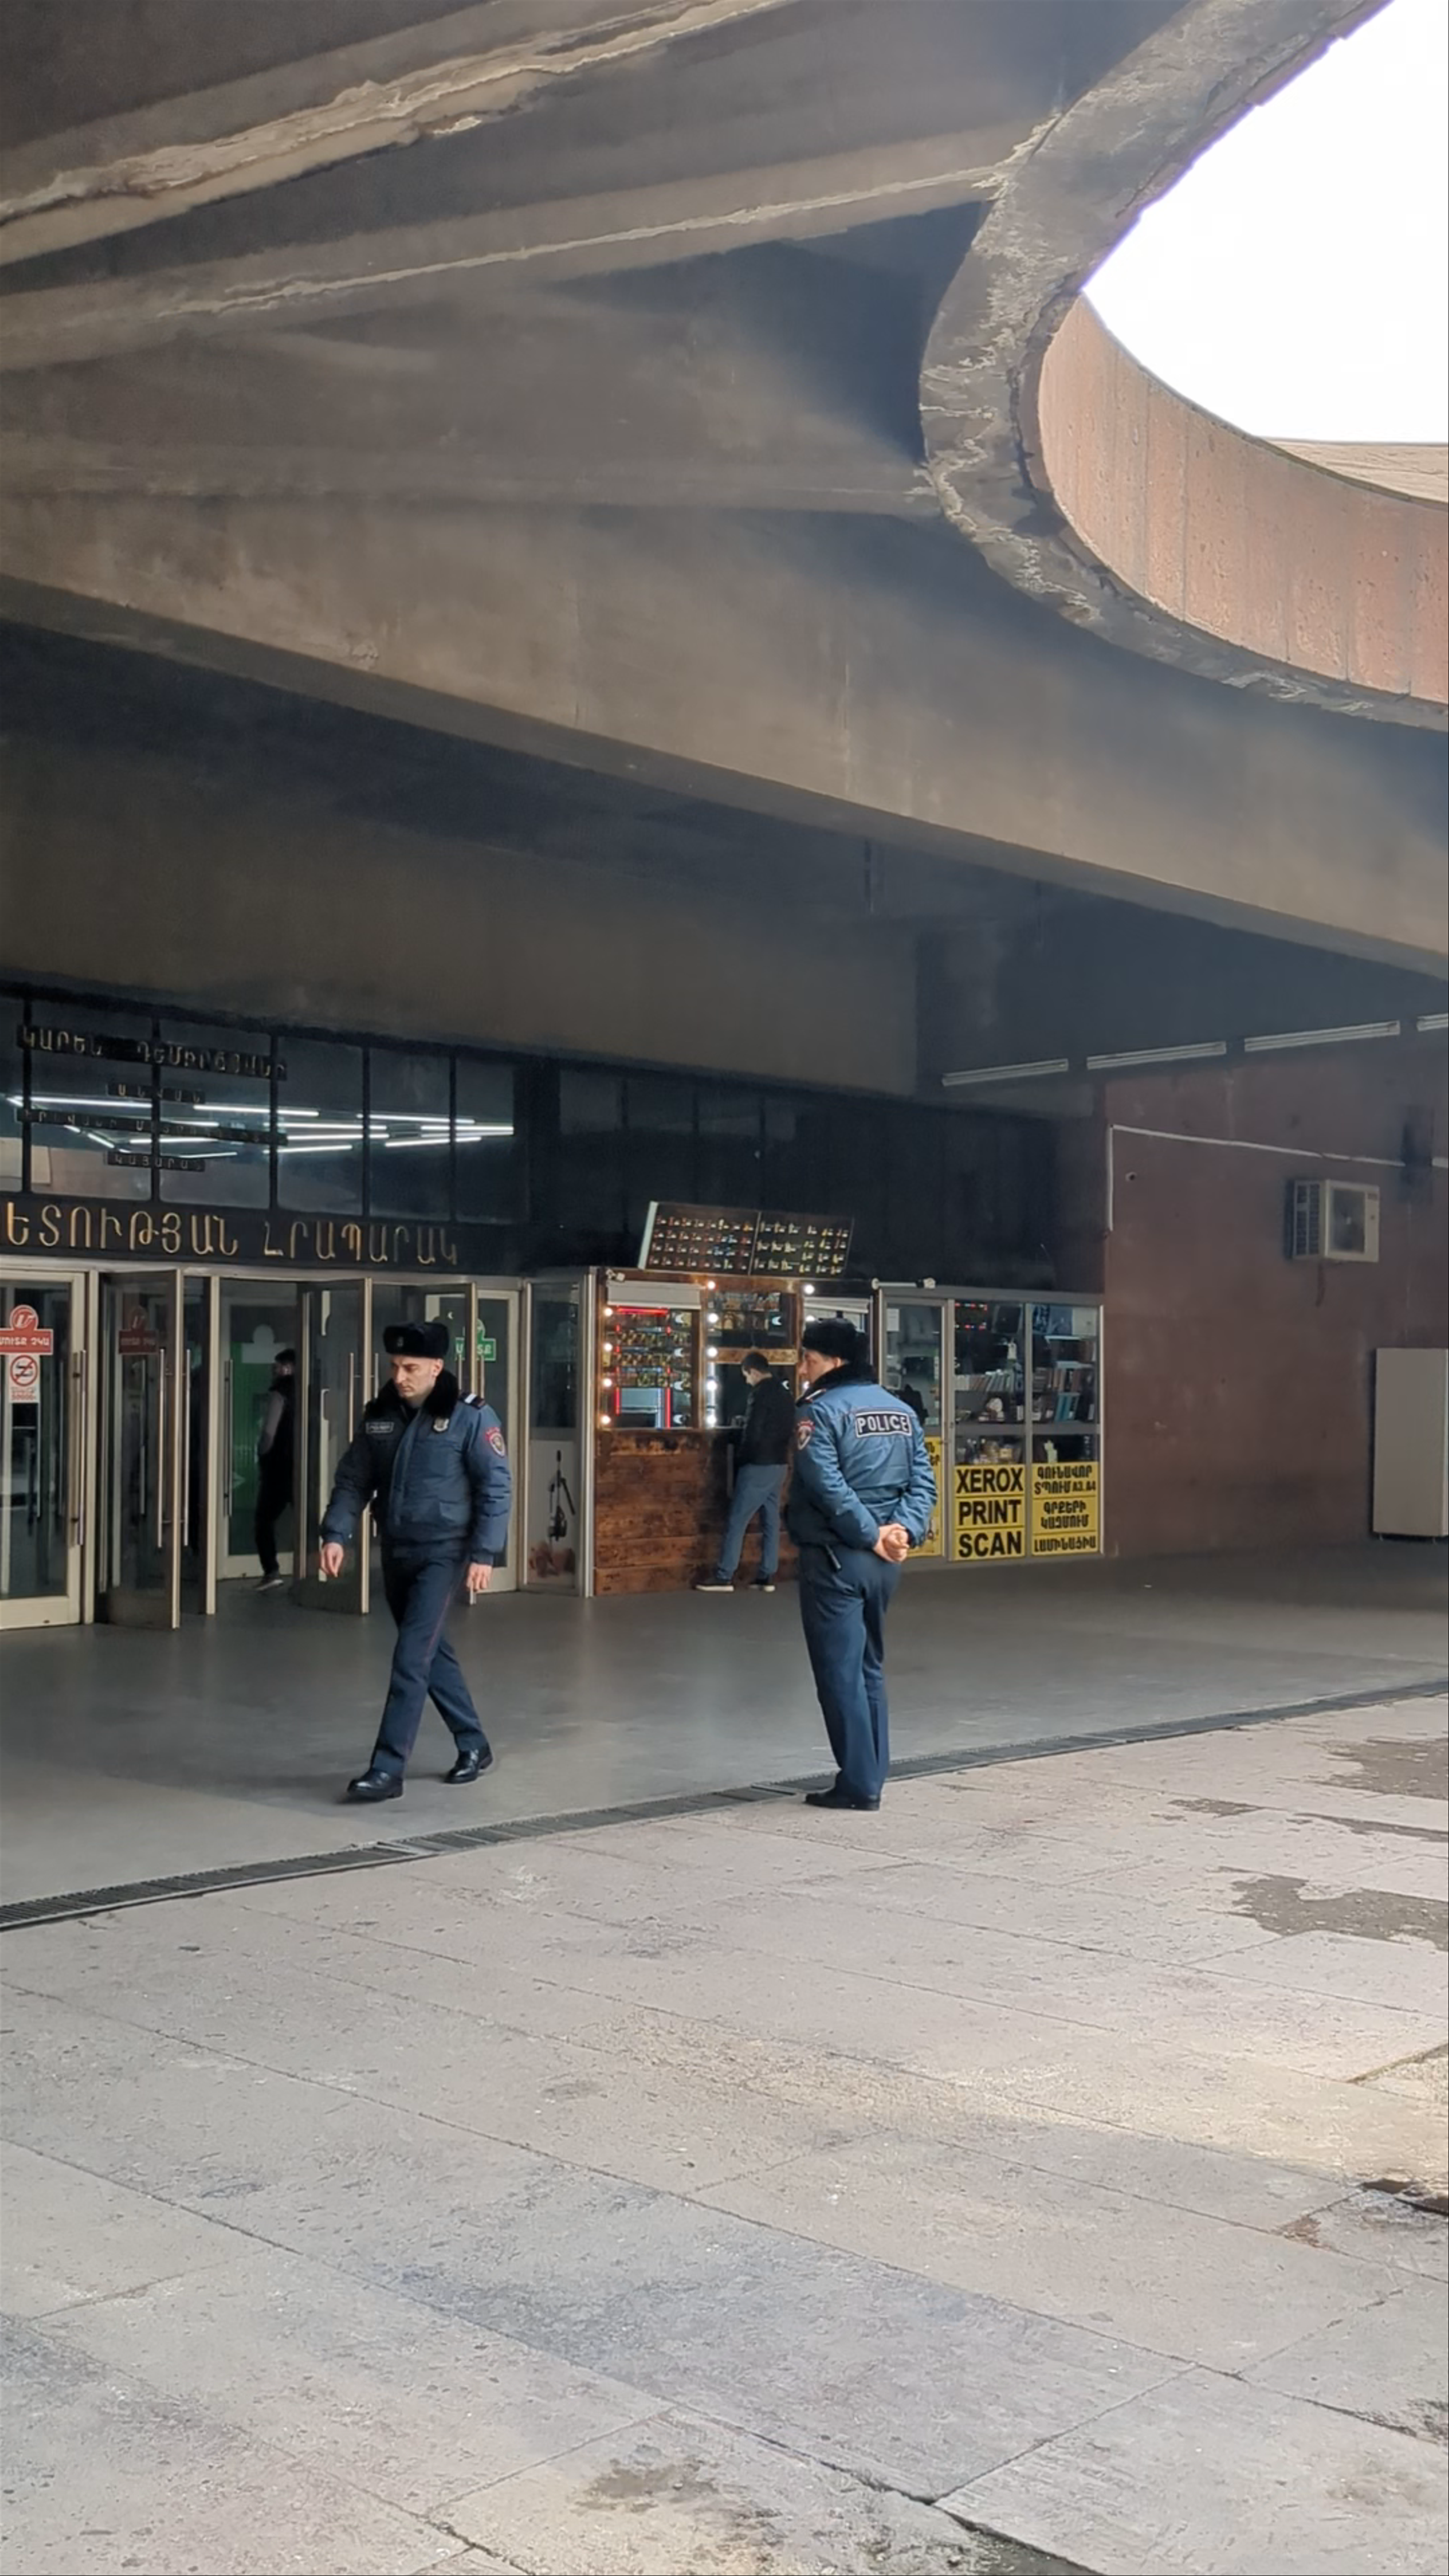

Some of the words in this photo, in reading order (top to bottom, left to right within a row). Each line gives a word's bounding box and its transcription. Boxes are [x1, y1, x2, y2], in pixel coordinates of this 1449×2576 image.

[23, 1026, 102, 1056] ԿԱՐԵՆ
[7, 1201, 238, 1256] ԵՏՈՒԹՅԱՆ
[264, 1220, 457, 1265] ՀՐԱՊԱՐԱԿ
[857, 1415, 909, 1433] POLICE
[956, 1467, 1023, 1493] XEROX
[1037, 1465, 1092, 1479] ԳՈՒՆԱՎՈՐ
[1034, 1481, 1071, 1495] ՏՊՈՒՄ
[958, 1499, 1021, 1526] PRINT
[1043, 1500, 1086, 1514] ԳՐՔԵՐԻ
[1041, 1514, 1089, 1529] ԿԱԶՄՈՒՄ
[958, 1531, 1022, 1558] SCAN
